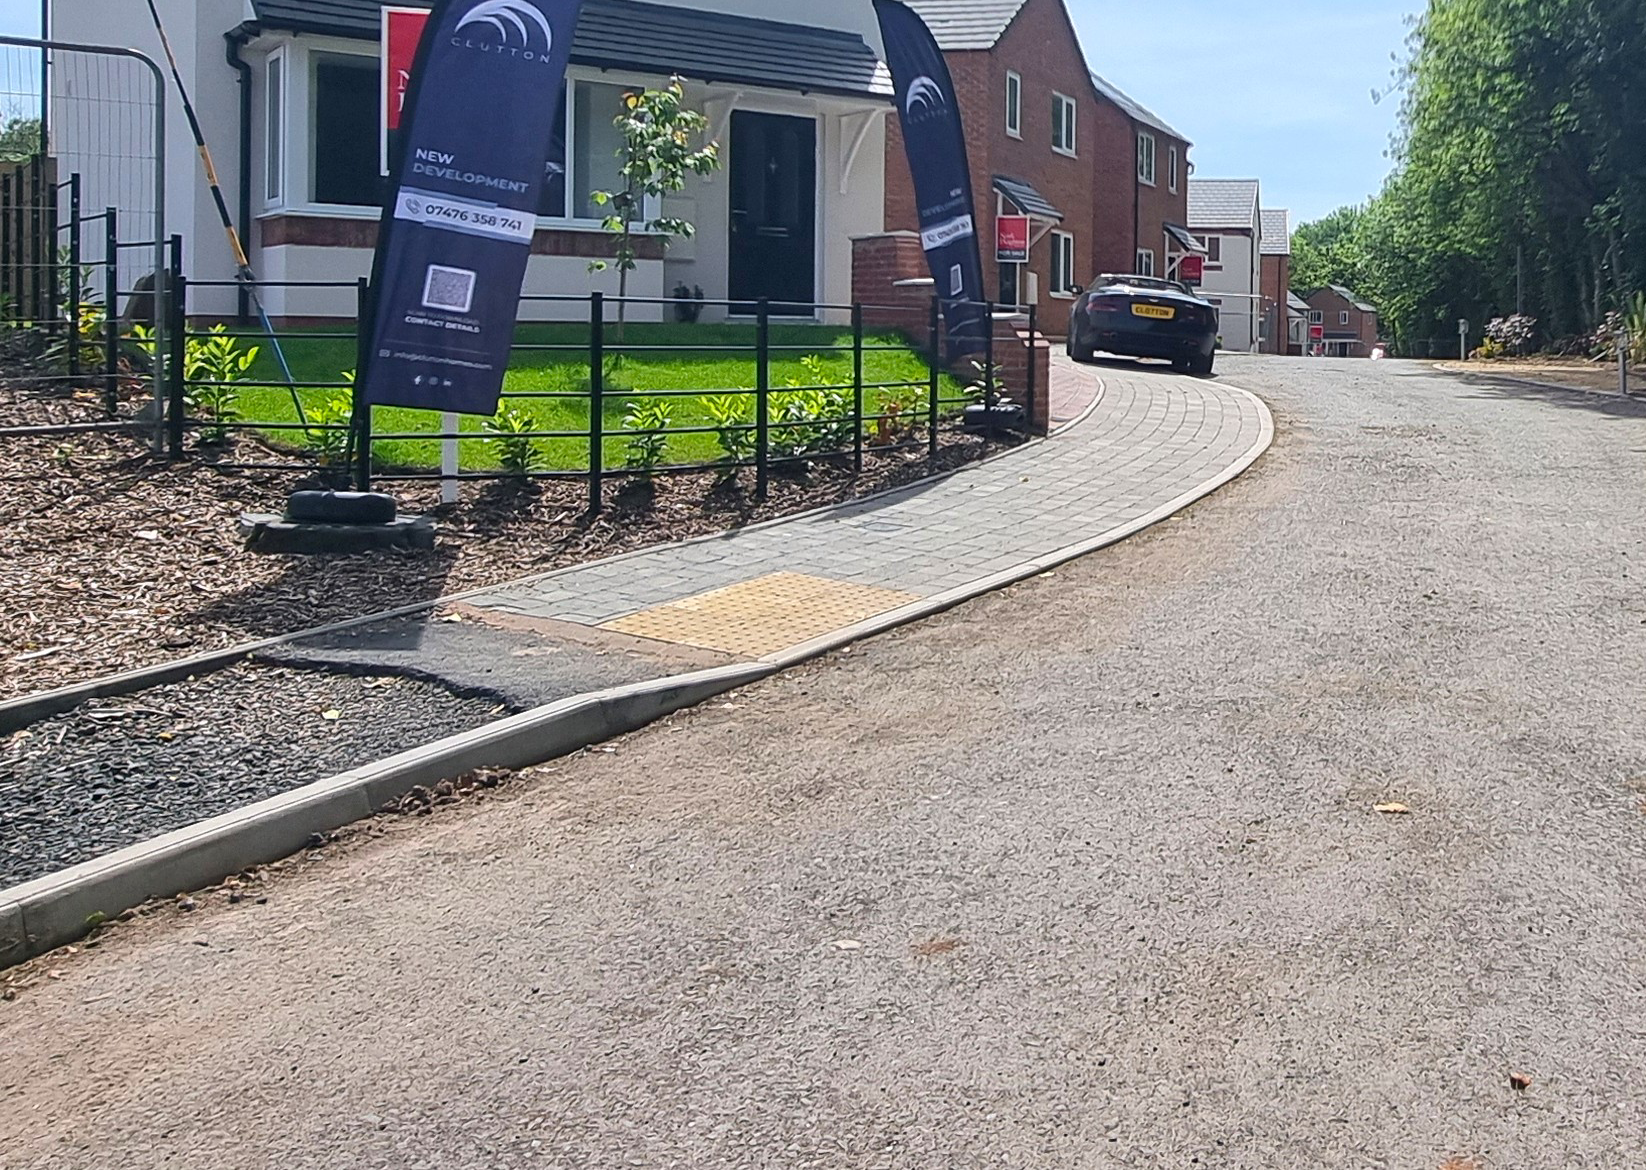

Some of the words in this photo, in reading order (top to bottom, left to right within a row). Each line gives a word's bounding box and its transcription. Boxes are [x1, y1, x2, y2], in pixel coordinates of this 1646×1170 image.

[451, 37, 550, 64] CLUTTON
[416, 148, 455, 165] NEW
[413, 163, 529, 193] DEVELOPMENT
[425, 204, 468, 221] 07476
[471, 212, 497, 226] 358
[500, 218, 522, 231] 741
[405, 316, 444, 328] CONTACT
[445, 321, 480, 333] DETAILS
